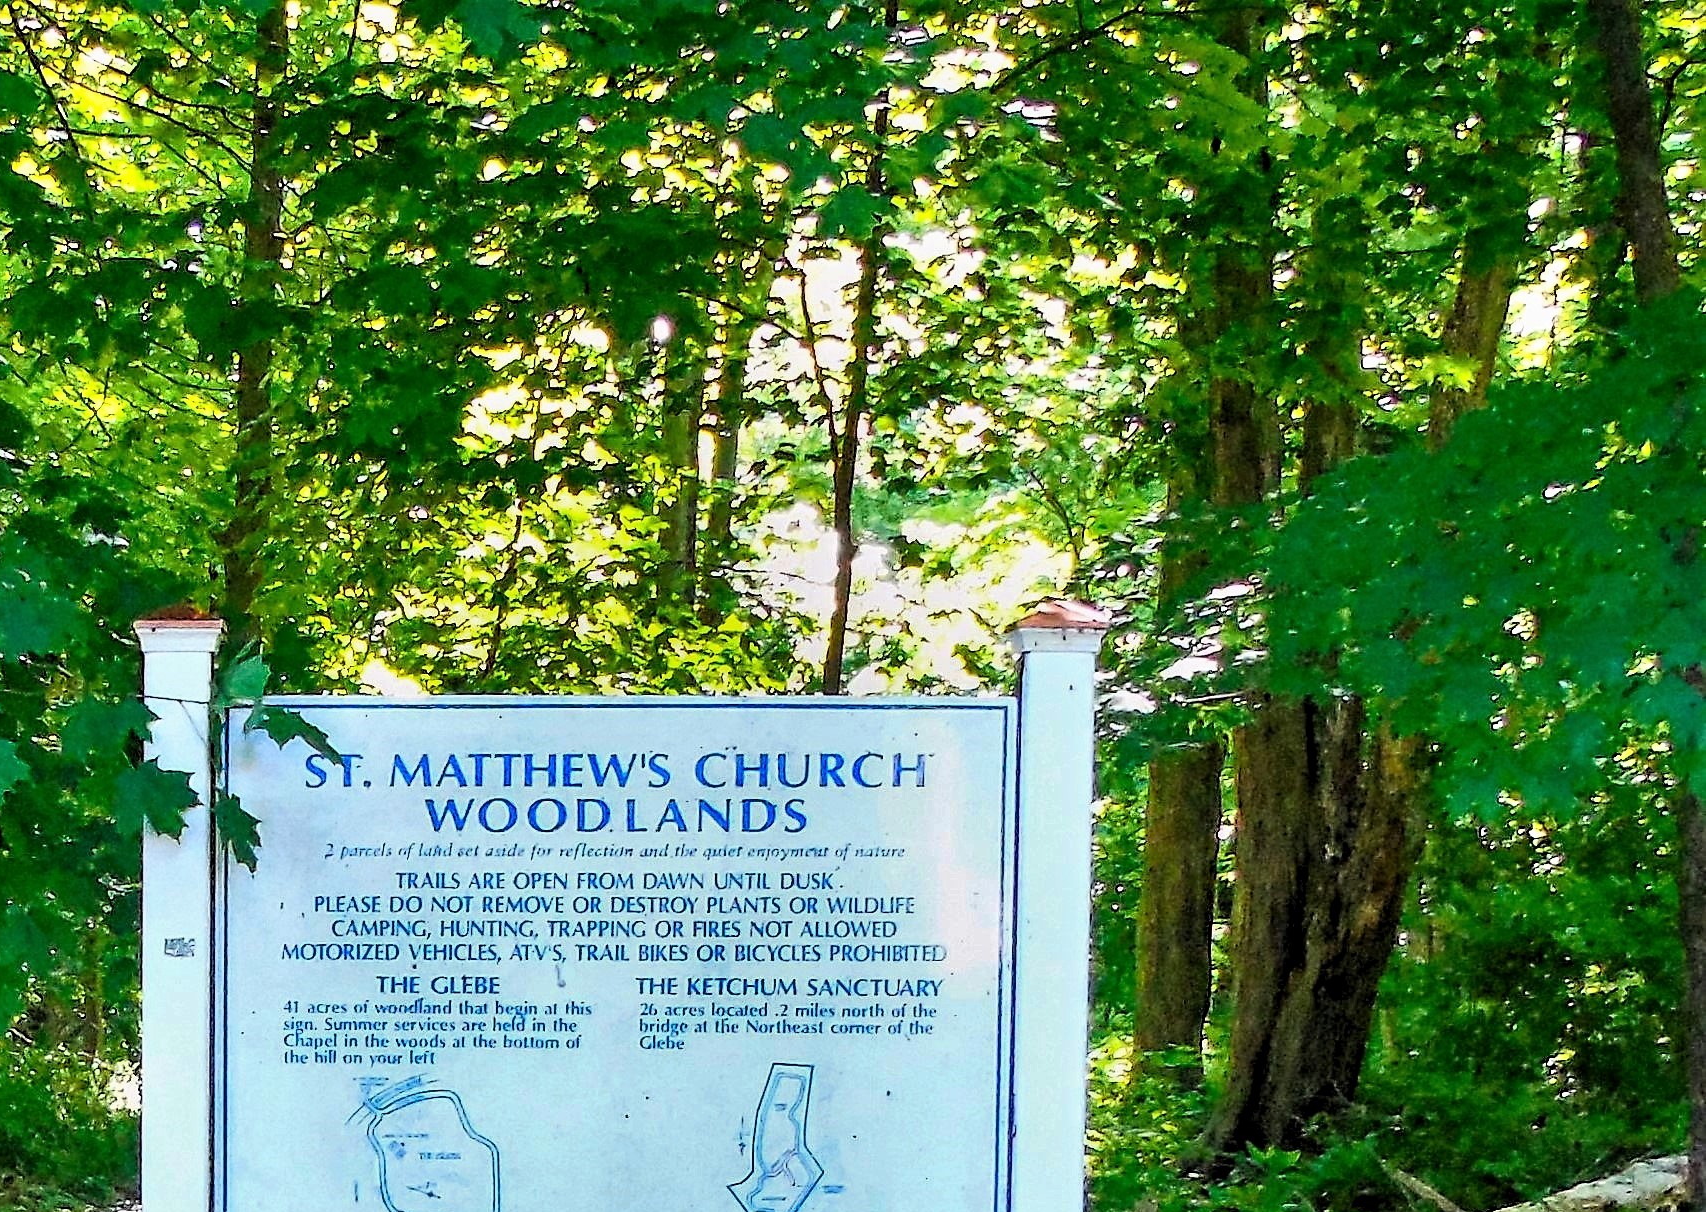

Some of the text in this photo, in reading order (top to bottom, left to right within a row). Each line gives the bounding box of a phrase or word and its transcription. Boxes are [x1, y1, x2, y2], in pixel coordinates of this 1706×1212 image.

[305, 752, 926, 788] ST. MATTHEW'S CHURCH
[425, 798, 807, 833] WOODLANDS
[396, 872, 460, 889] TRAILS
[469, 872, 505, 889] ARE
[513, 872, 567, 889] OPEN
[578, 873, 633, 889] FROM
[644, 873, 703, 889] DAWN
[715, 873, 770, 890] UNTIL
[315, 896, 914, 914] PLEASE DO NOT REMOVE OR DESTROY PLANTS OR WILDLIFE
[547, 920, 646, 937] TRAPPING
[655, 921, 683, 938] OR
[693, 921, 740, 937] FIRES
[750, 921, 793, 937] NOT
[801, 920, 897, 938] ALLOWED
[282, 944, 399, 960] MOTORIZED
[575, 944, 629, 961] TRAIL
[639, 945, 689, 962] BIKES
[697, 945, 725, 962] OR
[735, 945, 821, 962] BICYCLES
[830, 945, 946, 962] PROHIBITED
[376, 975, 500, 994] THE GLEBE
[636, 978, 942, 997] THE KETCHUM SANCTUARY
[284, 1001, 592, 1019] 41 acres woodland that begin this
[640, 1003, 657, 1016] 26
[665, 1006, 704, 1016] acres
[712, 1003, 767, 1017] located
[796, 1003, 835, 1017] miles
[842, 1004, 884, 1017] north
[913, 1004, 936, 1018] the
[325, 1018, 387, 1031] Summer
[395, 1018, 455, 1031] services
[462, 1021, 486, 1032] are
[493, 1018, 526, 1032] held
[533, 1018, 545, 1032] in
[554, 1018, 580, 1032] the
[640, 1019, 932, 1037] bridge the Northeast corner the
[284, 1034, 559, 1051] Chapel in the woods the bottom
[640, 1035, 684, 1049] Glebe
[285, 1050, 434, 1068] the hill on your left
